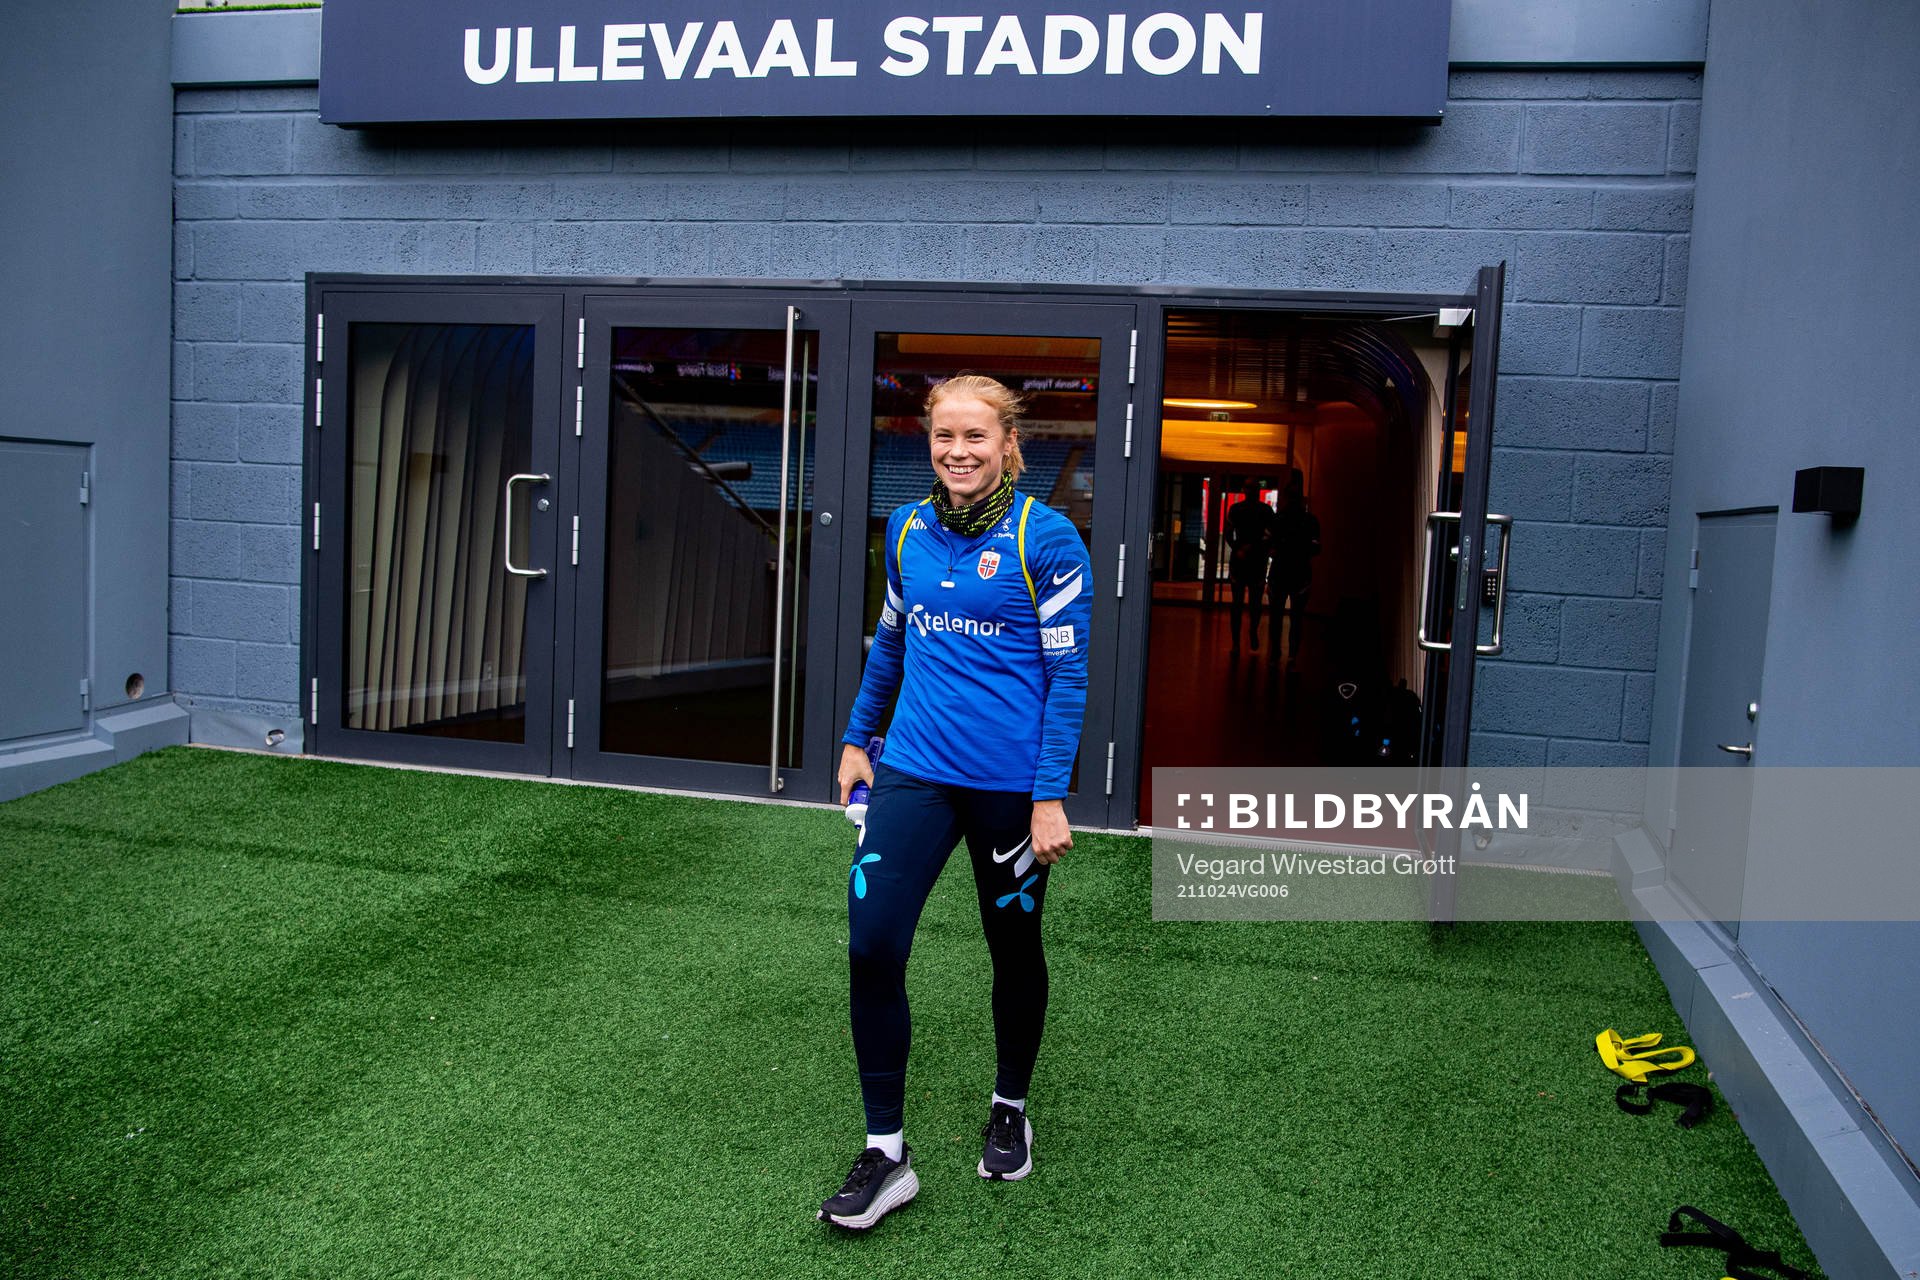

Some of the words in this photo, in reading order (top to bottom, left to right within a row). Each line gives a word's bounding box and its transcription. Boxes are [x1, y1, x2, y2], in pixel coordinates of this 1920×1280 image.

[463, 19, 857, 85] ULLEVAAL
[879, 13, 1264, 77] STADION
[923, 611, 1006, 636] telenor
